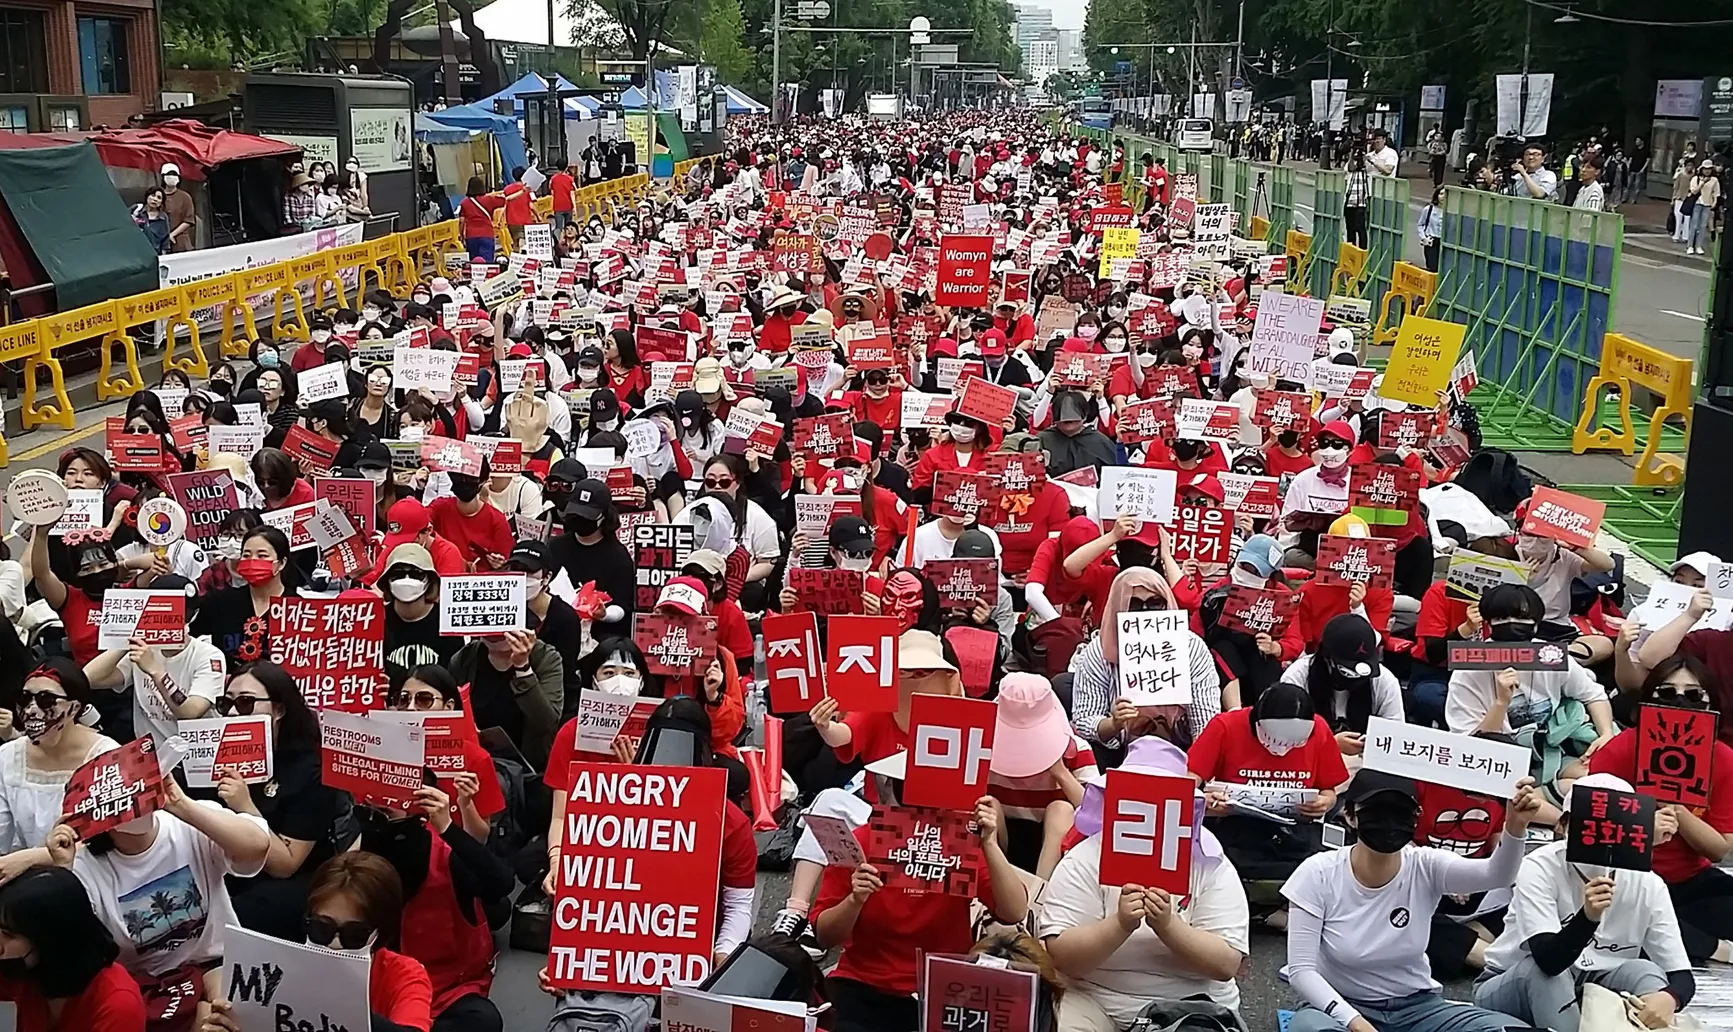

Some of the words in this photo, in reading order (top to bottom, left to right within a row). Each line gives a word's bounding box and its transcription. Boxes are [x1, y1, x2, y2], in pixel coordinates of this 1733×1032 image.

[1201, 217, 1222, 229] 너의
[777, 236, 808, 250] 여자가
[1196, 233, 1230, 242] 포르노가
[776, 251, 810, 270] 세상을
[946, 249, 986, 262] Womyn
[254, 274, 272, 286] POLICE
[274, 270, 285, 281] LINE
[955, 268, 974, 276] are
[199, 284, 218, 300] POLICE
[220, 281, 233, 296] LINE
[942, 282, 984, 293] Warrior
[1266, 296, 1290, 312] WE
[1290, 299, 1319, 318] ARE
[88, 312, 113, 329] 넘지마시오
[1261, 312, 1286, 328] THE
[18, 332, 36, 347] LINE
[1414, 334, 1440, 347] 여성은
[1253, 343, 1268, 352] OF
[1268, 344, 1285, 358] ALL
[400, 368, 420, 381] 세상을
[424, 370, 446, 380] 바꾼다
[1252, 356, 1308, 379] WITCHES
[1407, 364, 1429, 376] 우리는
[814, 424, 830, 432] 나의
[1205, 428, 1232, 436] 무고추
[814, 444, 836, 454] 아니다
[192, 475, 212, 487] GO
[1378, 470, 1395, 482] 나의
[15, 480, 40, 490] ANGRY
[17, 487, 44, 496] WOMAN
[186, 485, 224, 500] WILD
[326, 484, 364, 500] 우리는
[960, 480, 977, 490] 나의
[20, 496, 38, 504] WILL
[22, 496, 54, 509] CHANGE
[186, 498, 232, 512] SPEAK
[1128, 493, 1144, 504] 올린
[1370, 493, 1398, 504] 아니다
[24, 508, 40, 516] THE
[42, 502, 64, 510] WORLD
[796, 502, 832, 512] 무죄추정
[952, 504, 978, 514] 아니다
[1239, 503, 1274, 514] 무고추정
[636, 526, 694, 548] 우리는
[1348, 545, 1368, 557] 나의
[953, 566, 971, 577] 나의
[1330, 561, 1350, 572] 너의
[1350, 564, 1382, 575] 포르노가
[1340, 572, 1370, 582] 아니다
[454, 590, 474, 600] 징역
[477, 590, 508, 600] 333년
[938, 584, 954, 592] 너의
[948, 591, 976, 601] 아니다
[1256, 596, 1275, 609] 나의
[104, 598, 144, 611] 무죄추정
[270, 597, 318, 632] 여자는
[322, 602, 376, 634] 귀찮다
[1236, 609, 1254, 620] 너의
[667, 624, 686, 638] 나의
[1122, 614, 1185, 635] 여자가
[1244, 620, 1272, 632] 아니다
[662, 637, 688, 648] 일상은
[648, 645, 666, 656] 너의
[667, 646, 703, 658] 포르노가
[1124, 641, 1177, 664] 역사를
[660, 655, 692, 668] 아니다
[768, 630, 816, 700] 찍
[836, 635, 893, 688] 지
[1126, 666, 1182, 694] 바꾼다
[339, 674, 377, 705] 한강
[580, 699, 630, 716] 무죄추정
[324, 726, 382, 746] RESTROOMS
[324, 736, 342, 749] FOR
[344, 741, 366, 754] MEN
[426, 754, 465, 769] 고추정
[914, 724, 992, 786] 마
[1376, 736, 1391, 754] 내
[1400, 740, 1452, 766] 보지를
[1458, 752, 1512, 779] 보지마
[94, 764, 120, 782] 나의
[339, 754, 378, 770] ILLEGAL
[380, 764, 420, 778] FILMING
[332, 762, 359, 776] SITES
[360, 768, 380, 782] FOR
[382, 773, 421, 789] WOMEN
[1239, 769, 1271, 778] GIRLS
[1274, 770, 1296, 778] CAN
[1298, 772, 1311, 780] DO
[88, 775, 124, 798] 일상은
[570, 770, 690, 808] ANGRY
[1247, 779, 1306, 789] ANYTHING.
[74, 796, 98, 814] 너의
[98, 778, 146, 805] 포르노가
[92, 795, 134, 821] 아니다
[567, 813, 696, 853] WOMEN
[914, 821, 941, 840] 나의
[1113, 800, 1192, 871] 라
[1580, 819, 1648, 854] 공화국
[906, 838, 943, 854] 일상은
[888, 848, 912, 863] 너의
[914, 850, 962, 870] 포르노가
[563, 854, 642, 892] WILL
[904, 863, 946, 882] 아니다
[555, 896, 700, 939] CHANGE
[551, 946, 610, 984] THE
[614, 949, 710, 987] WORLD
[228, 962, 284, 1007] MY
[945, 982, 1016, 1014] 우리는
